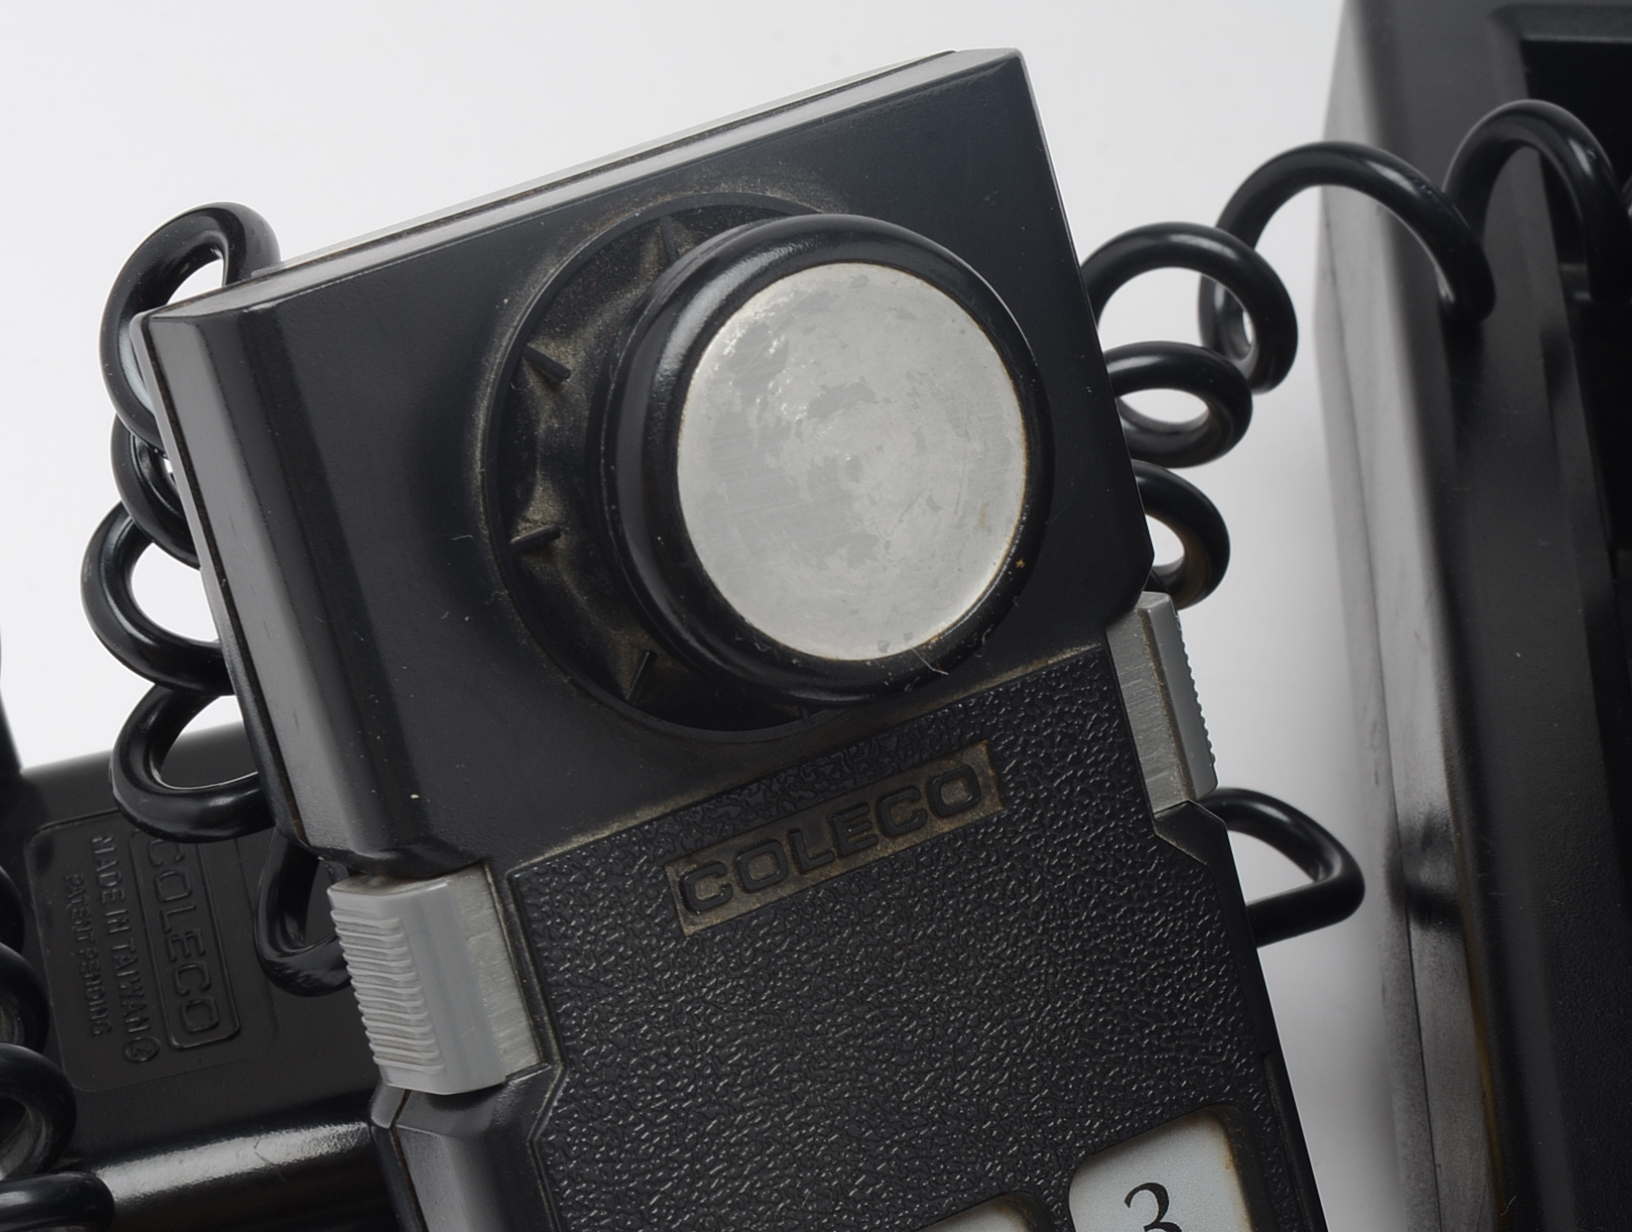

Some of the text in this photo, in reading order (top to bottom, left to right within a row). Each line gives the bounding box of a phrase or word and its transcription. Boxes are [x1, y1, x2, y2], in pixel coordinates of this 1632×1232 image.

[91, 835, 126, 904] MADE
[679, 765, 981, 914] COLECO
[64, 872, 112, 1038] PATENT PENDING
[105, 909, 131, 934] IN
[148, 839, 220, 1035] COLECO
[112, 938, 150, 1036] TAIWAN
